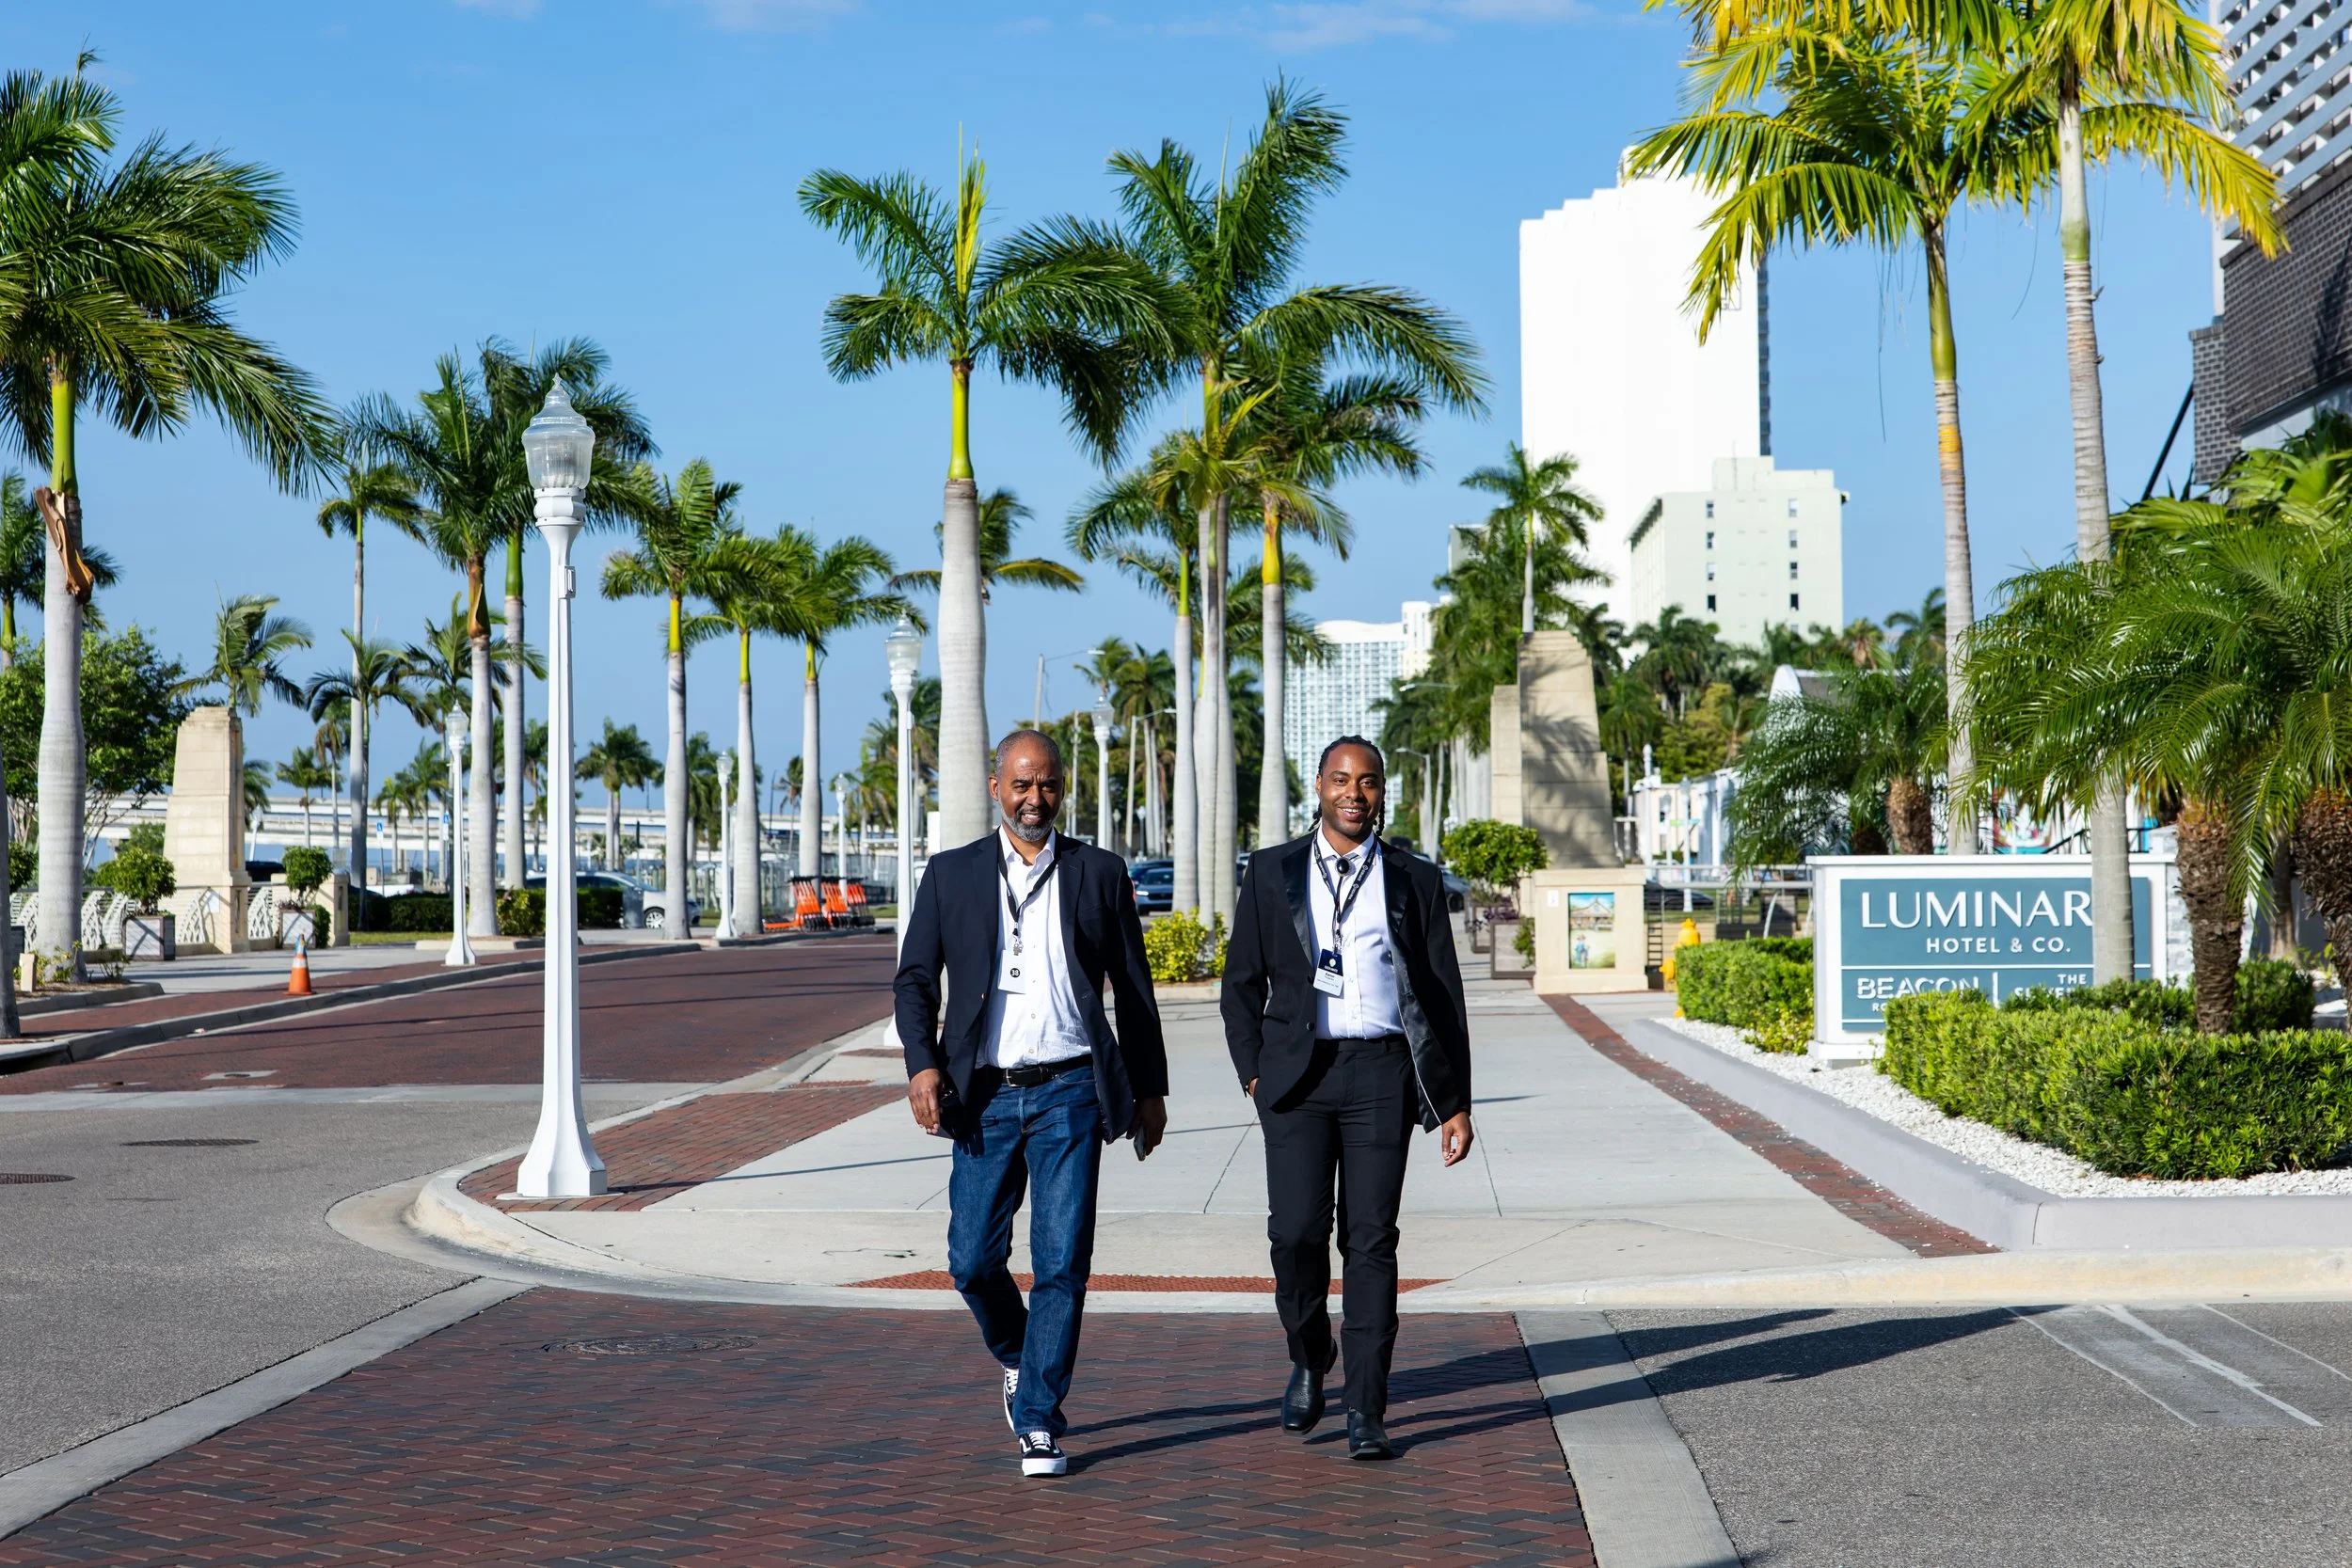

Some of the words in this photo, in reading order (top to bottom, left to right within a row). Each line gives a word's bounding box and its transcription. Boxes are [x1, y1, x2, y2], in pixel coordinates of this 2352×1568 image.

[1862, 890, 2093, 929] LUMINAR
[1927, 937, 2000, 953] HOTEL
[2010, 937, 2023, 953] &
[2032, 937, 2071, 953] CO.
[1857, 976, 1979, 999] BEACON
[2057, 974, 2087, 985] THE
